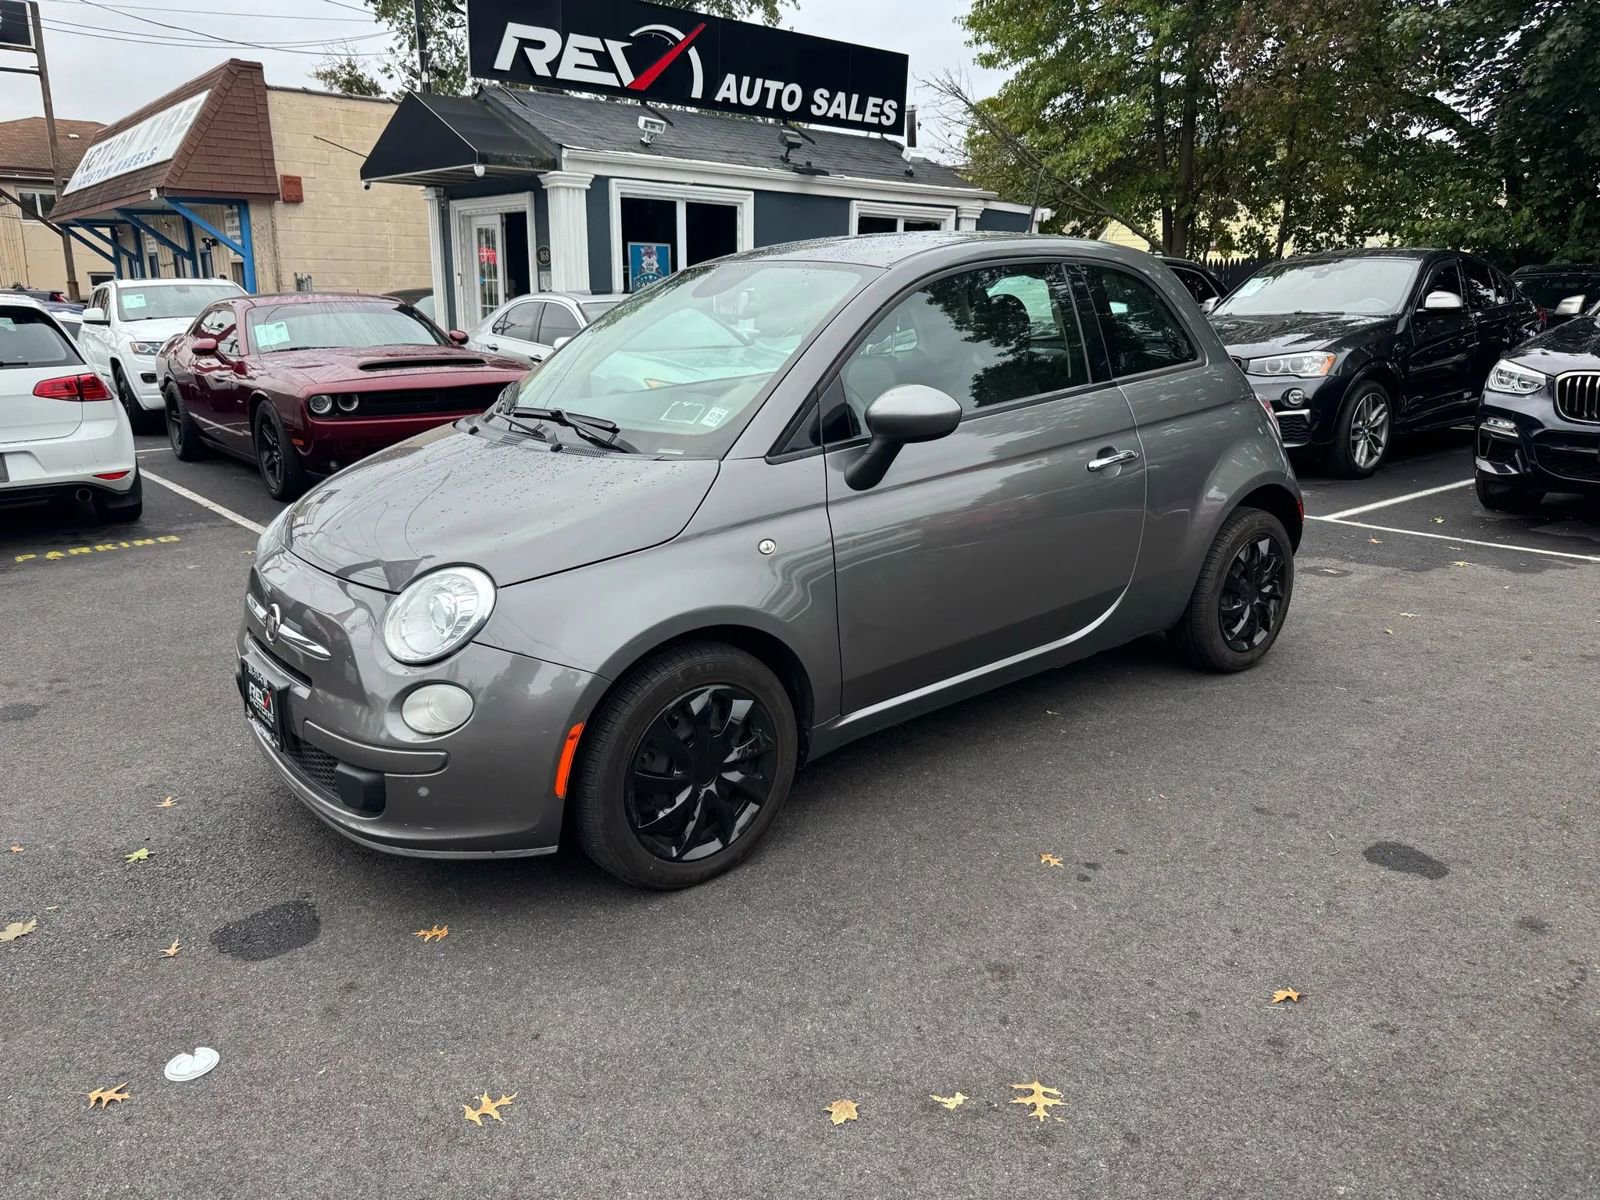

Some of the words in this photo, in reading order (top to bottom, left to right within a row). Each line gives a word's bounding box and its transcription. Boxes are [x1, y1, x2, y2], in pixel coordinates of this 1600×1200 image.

[715, 73, 802, 112] AUTO
[810, 88, 898, 126] SALES
[113, 145, 159, 173] WHEELS
